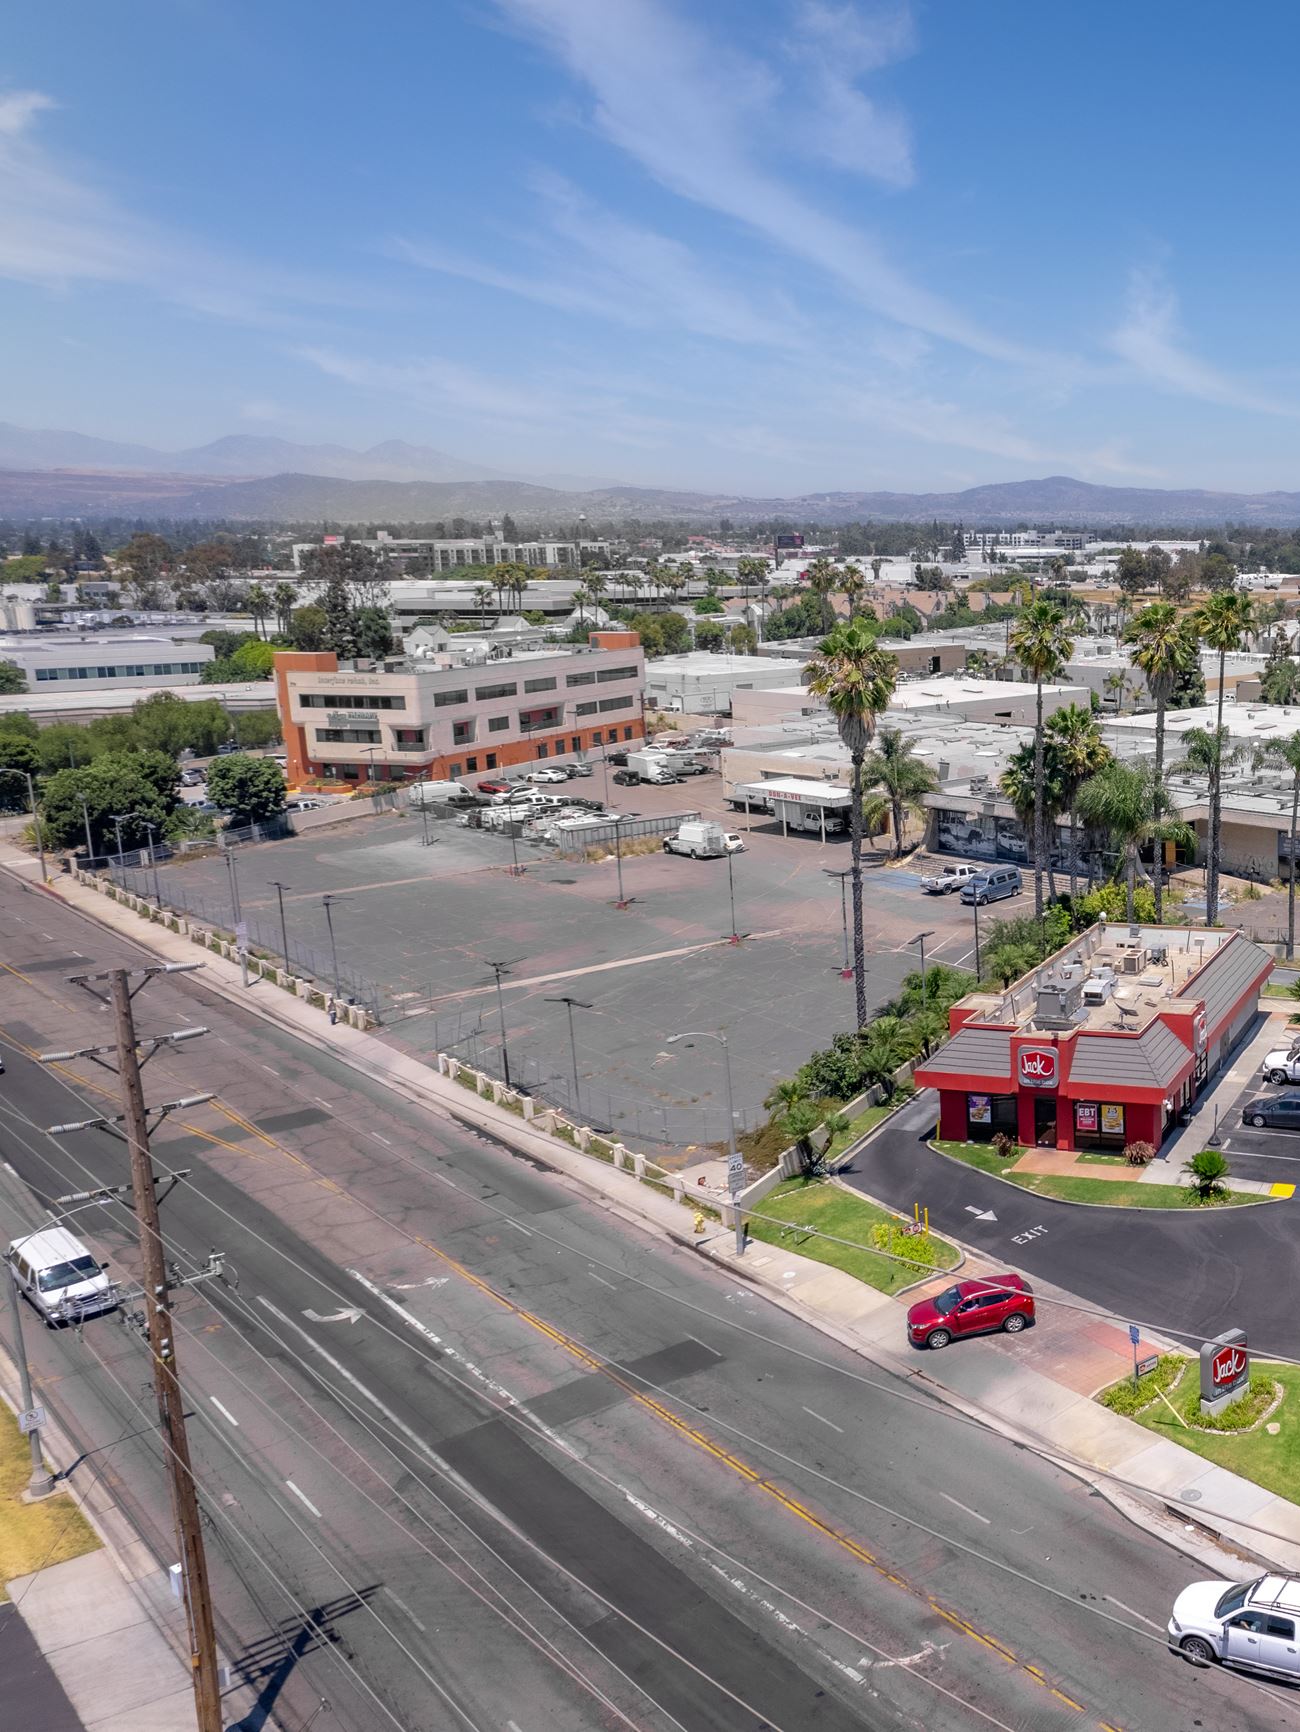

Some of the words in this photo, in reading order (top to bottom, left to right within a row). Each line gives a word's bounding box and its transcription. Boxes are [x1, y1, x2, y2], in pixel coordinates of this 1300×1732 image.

[1022, 1055, 1054, 1076] Jack
[1079, 1108, 1096, 1117] EBT
[730, 1162, 743, 1171] 40
[1010, 1225, 1049, 1245] EXIT
[1214, 1349, 1246, 1383] Jack
